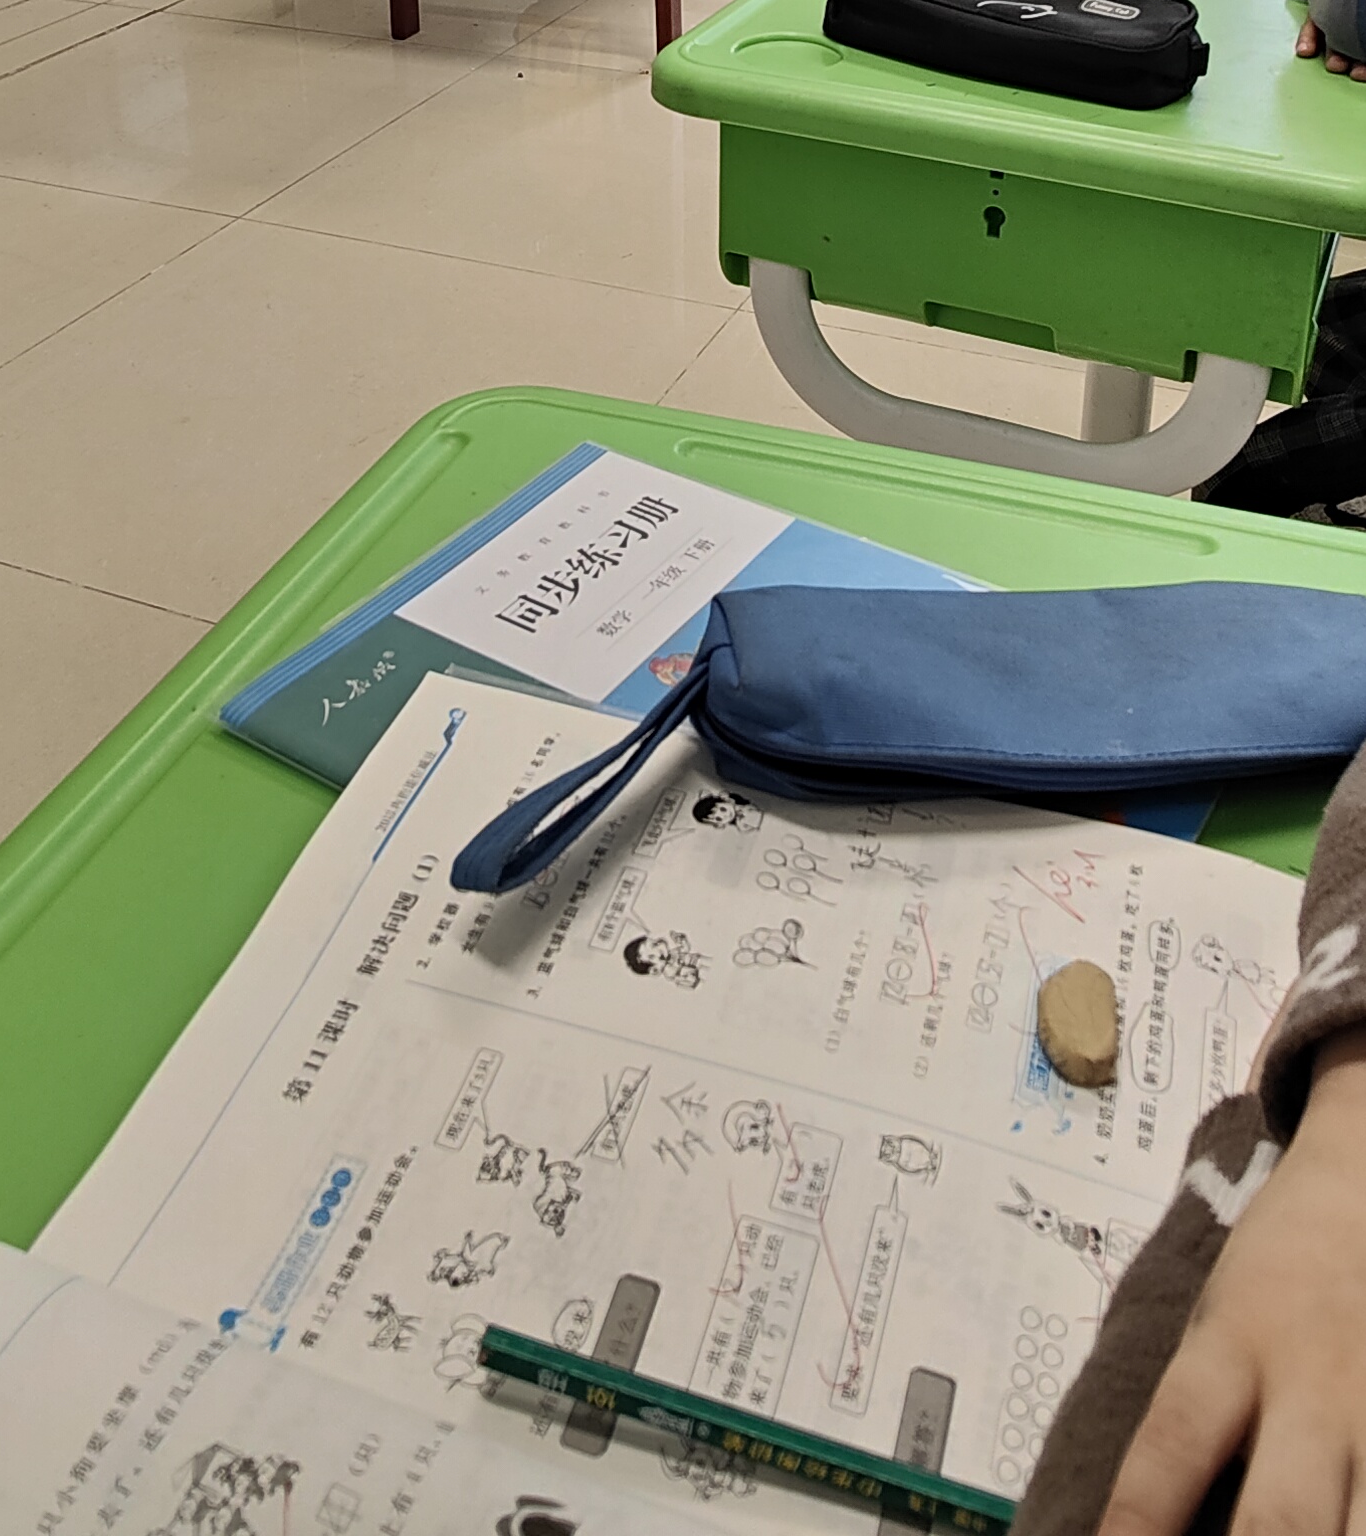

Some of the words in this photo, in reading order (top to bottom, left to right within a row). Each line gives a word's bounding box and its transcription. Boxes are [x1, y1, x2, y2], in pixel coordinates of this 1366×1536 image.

[494, 495, 680, 634] 同步练习册
[596, 608, 634, 638] 数学
[641, 563, 688, 601] 一年级
[682, 537, 716, 562] 下册
[586, 1385, 617, 1410] 101
